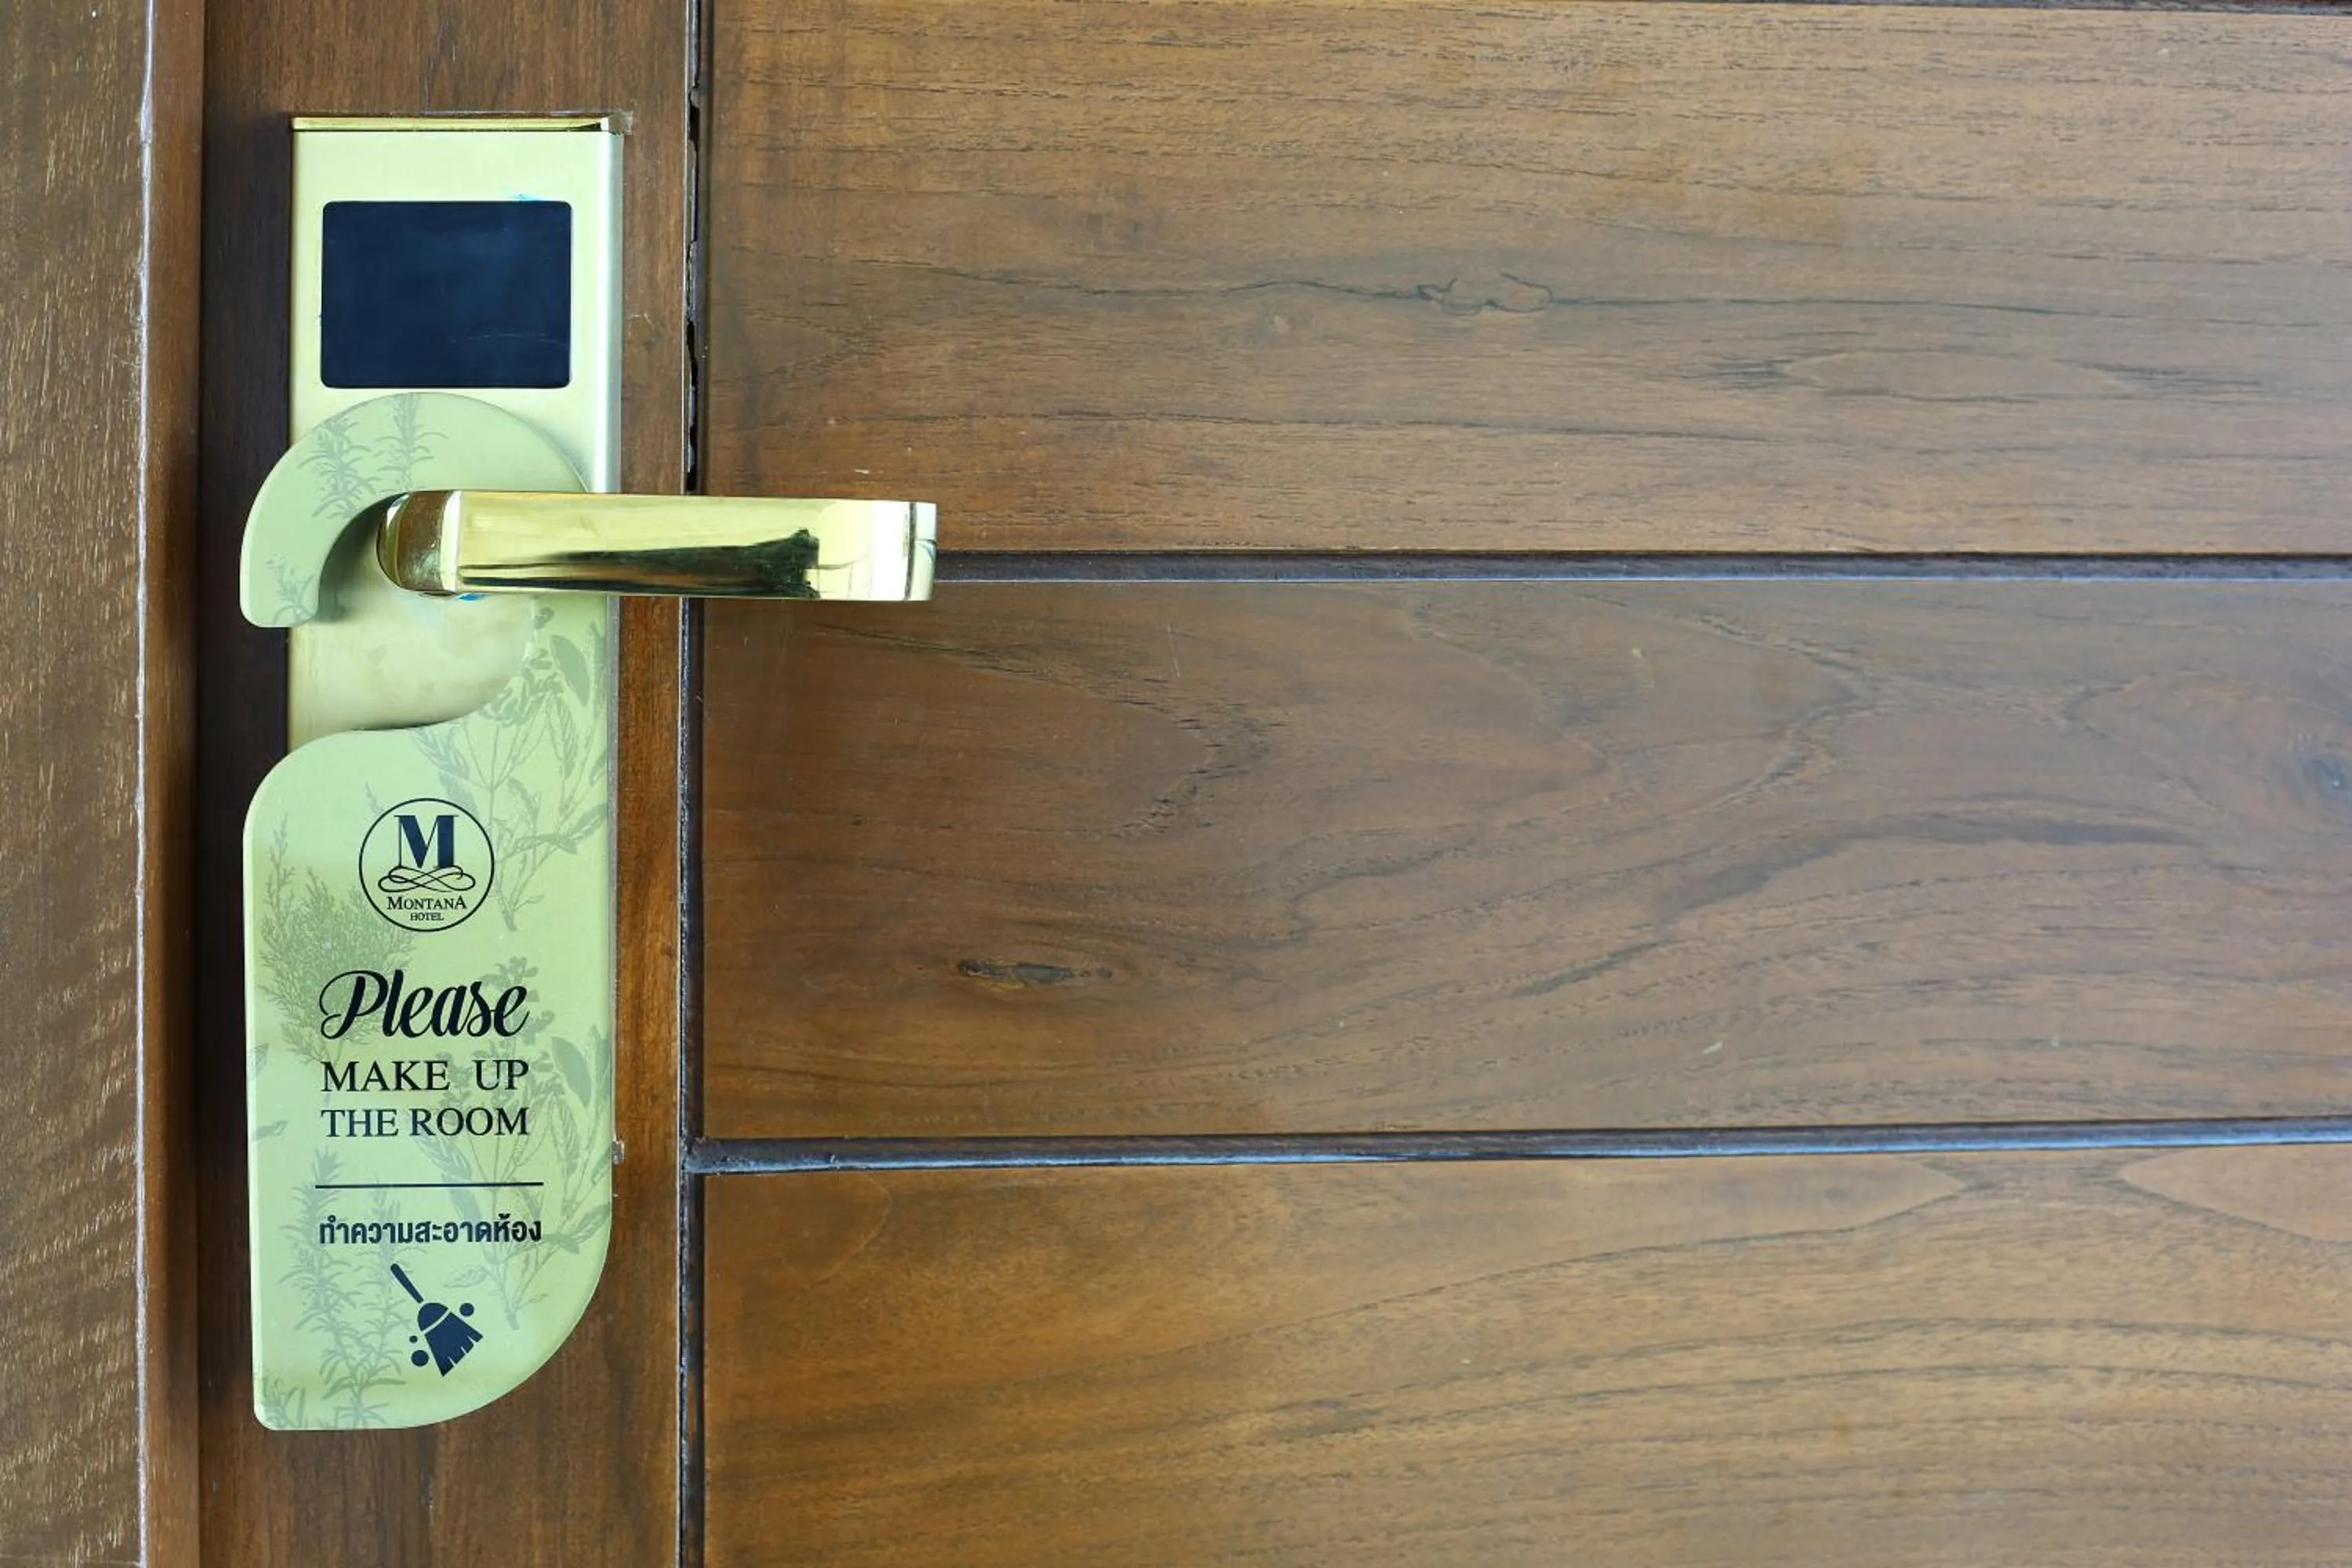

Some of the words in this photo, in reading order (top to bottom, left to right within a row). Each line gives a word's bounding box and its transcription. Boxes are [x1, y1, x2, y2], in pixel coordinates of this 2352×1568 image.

[394, 815, 459, 869] M
[410, 912, 445, 921] HOTEL
[319, 969, 530, 1039] Please
[321, 1060, 451, 1092] MAKE
[474, 1059, 529, 1091] UP
[321, 1109, 399, 1138] THE
[409, 1107, 530, 1137] ROOM
[318, 1213, 543, 1244] ทำความสะอาดห้อง
